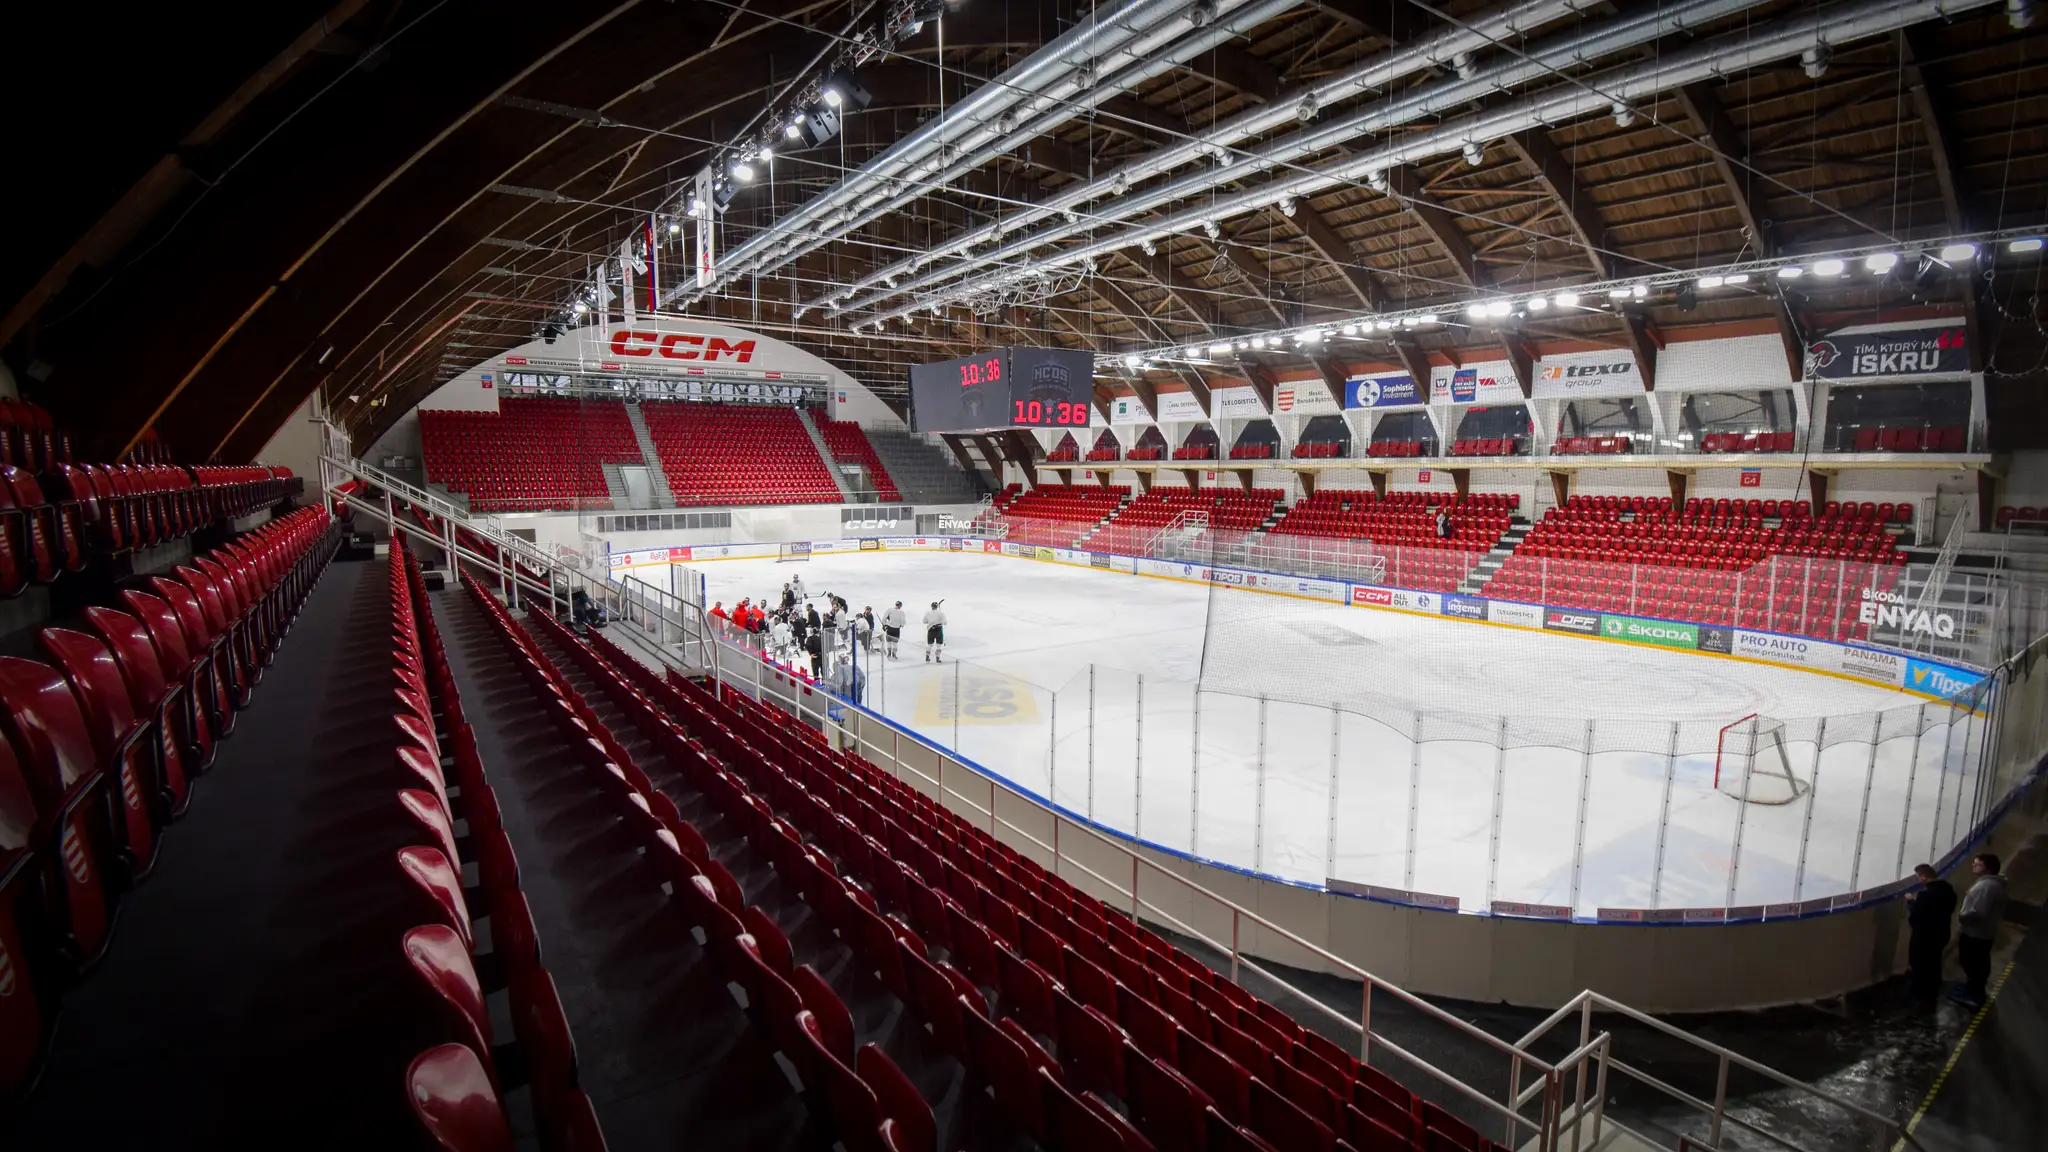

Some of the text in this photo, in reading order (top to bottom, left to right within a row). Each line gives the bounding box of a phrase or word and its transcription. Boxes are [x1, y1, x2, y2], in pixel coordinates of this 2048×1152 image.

[610, 331, 756, 363] CCM
[1880, 339, 1918, 353] KTORÝ
[1566, 362, 1631, 378] texo
[1852, 350, 1940, 374] ISKRU
[960, 358, 1000, 386] 10:36
[1383, 383, 1414, 394] Sophistic
[1565, 379, 1602, 388] group
[1014, 400, 1087, 424] 10:36
[844, 520, 898, 529] CCM
[938, 520, 972, 529] ENYAQ
[1214, 571, 1240, 584] TIPOS
[1355, 589, 1390, 602] CCM
[1862, 588, 1904, 604] ŠKODA
[1447, 601, 1481, 614] ingema
[1859, 601, 1955, 639] ENYAQ
[1628, 623, 1692, 642] ŠKODA
[1740, 634, 1767, 646] PRO
[1770, 639, 1808, 653] AUTO
[1844, 647, 1898, 666] PANAMA
